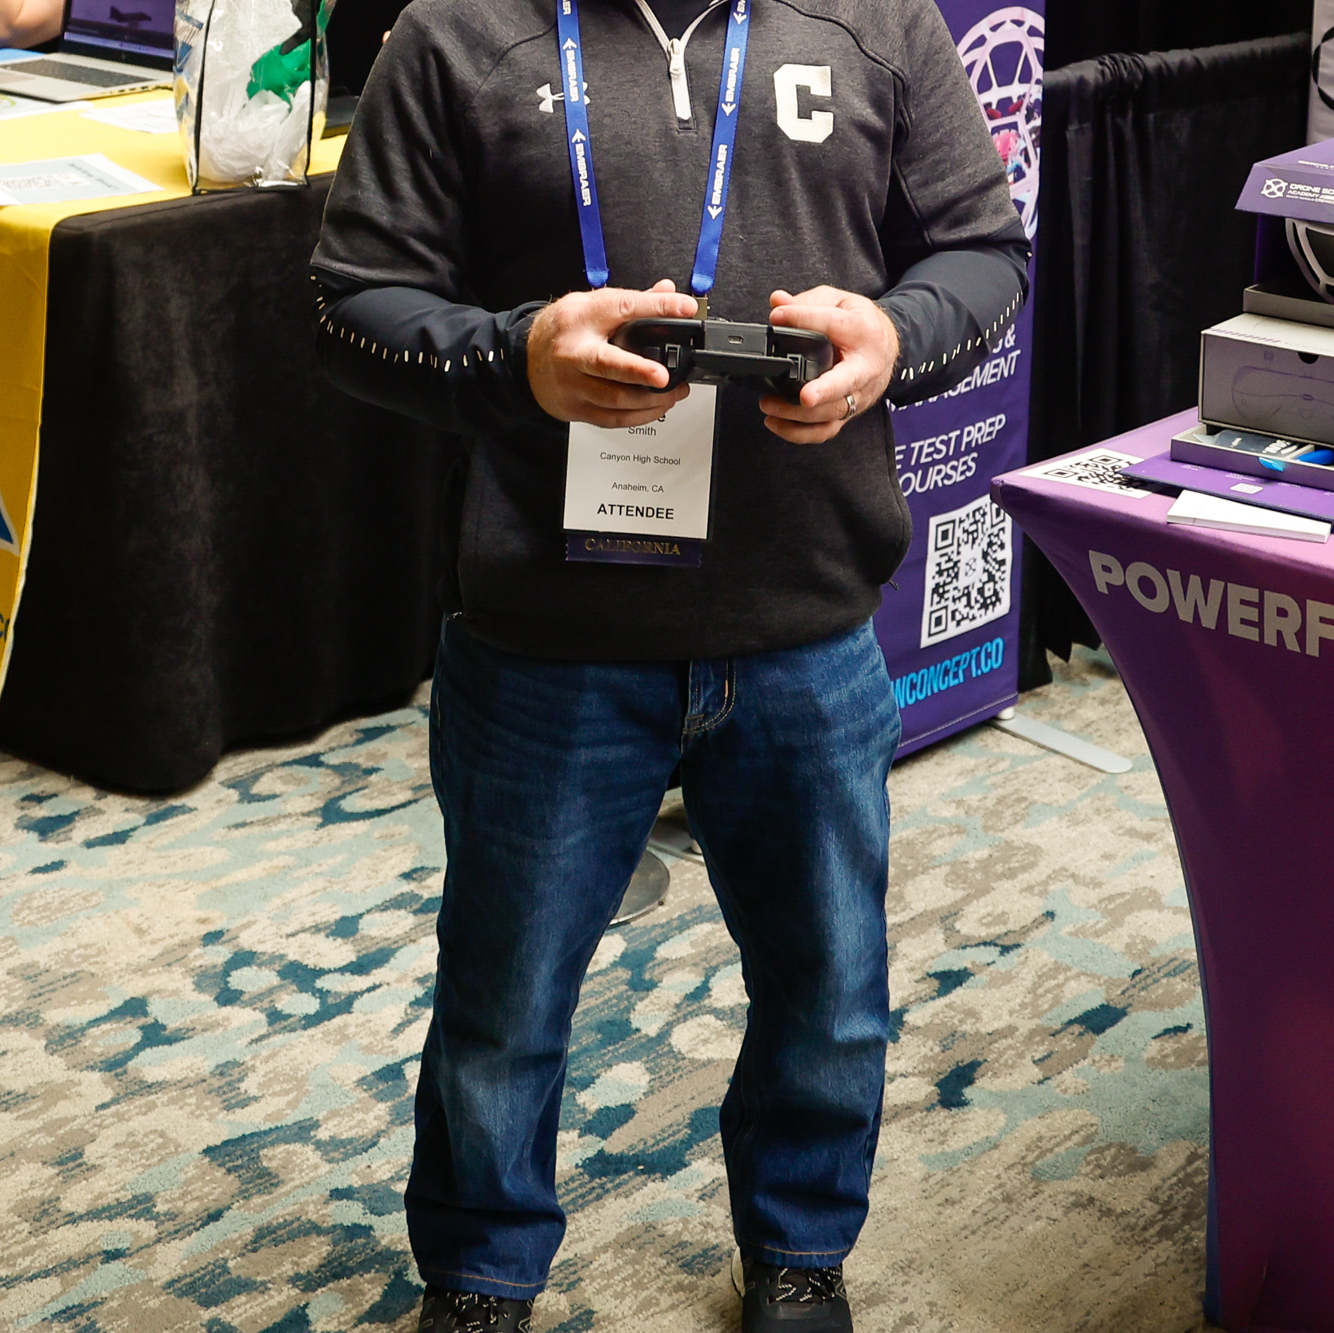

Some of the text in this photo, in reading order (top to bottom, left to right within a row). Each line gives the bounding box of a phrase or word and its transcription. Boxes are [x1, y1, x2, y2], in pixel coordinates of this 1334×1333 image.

[566, 49, 579, 103] EMBRAER
[725, 47, 740, 103] EMBRAER
[773, 63, 834, 144] C
[574, 142, 592, 206] EMBRAER
[711, 143, 728, 205] EMBRAER
[1290, 183, 1320, 193] DRONE
[1287, 190, 1320, 199] ACADEMY
[628, 426, 656, 436] Smith
[909, 431, 960, 465] TEST
[962, 413, 1007, 449] PREP
[600, 452, 681, 466] Canyon High School
[612, 482, 664, 493] Anaheim, CA
[899, 453, 978, 497] OURSES
[597, 503, 674, 520] ATTENDEE
[585, 537, 681, 555] CALIFORNIA
